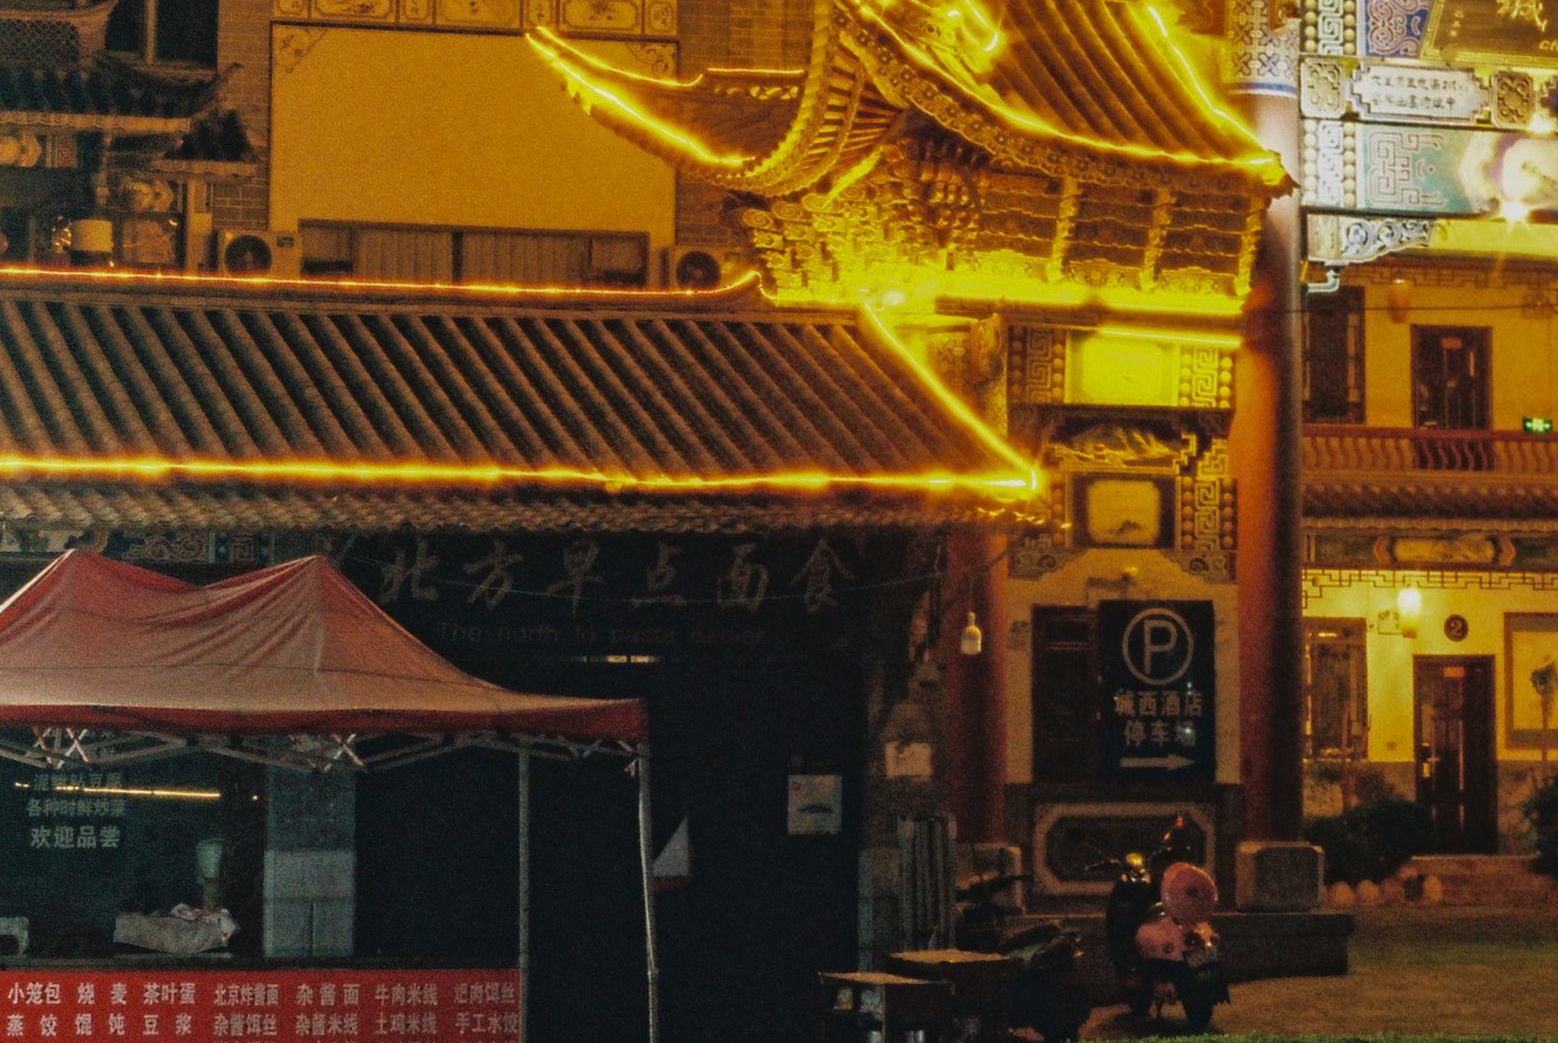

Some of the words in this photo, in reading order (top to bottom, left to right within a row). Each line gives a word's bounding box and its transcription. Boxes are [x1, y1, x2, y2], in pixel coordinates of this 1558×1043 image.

[377, 536, 857, 618] 北方早点面食
[438, 622, 483, 642] The
[1113, 690, 1204, 717] 城西酒店
[1123, 719, 1197, 747] 停车场
[30, 824, 122, 849] 欢迎品尝
[7, 982, 61, 1005] 小笼包
[143, 982, 196, 1005] 茶叶蛋
[213, 983, 280, 1006] 北京炸酱面
[374, 983, 438, 1006] 牛肉米线
[295, 1012, 359, 1036] 杂酱米线
[374, 1011, 438, 1035] 土鸡米线
[454, 1011, 519, 1036] 手工水饺
